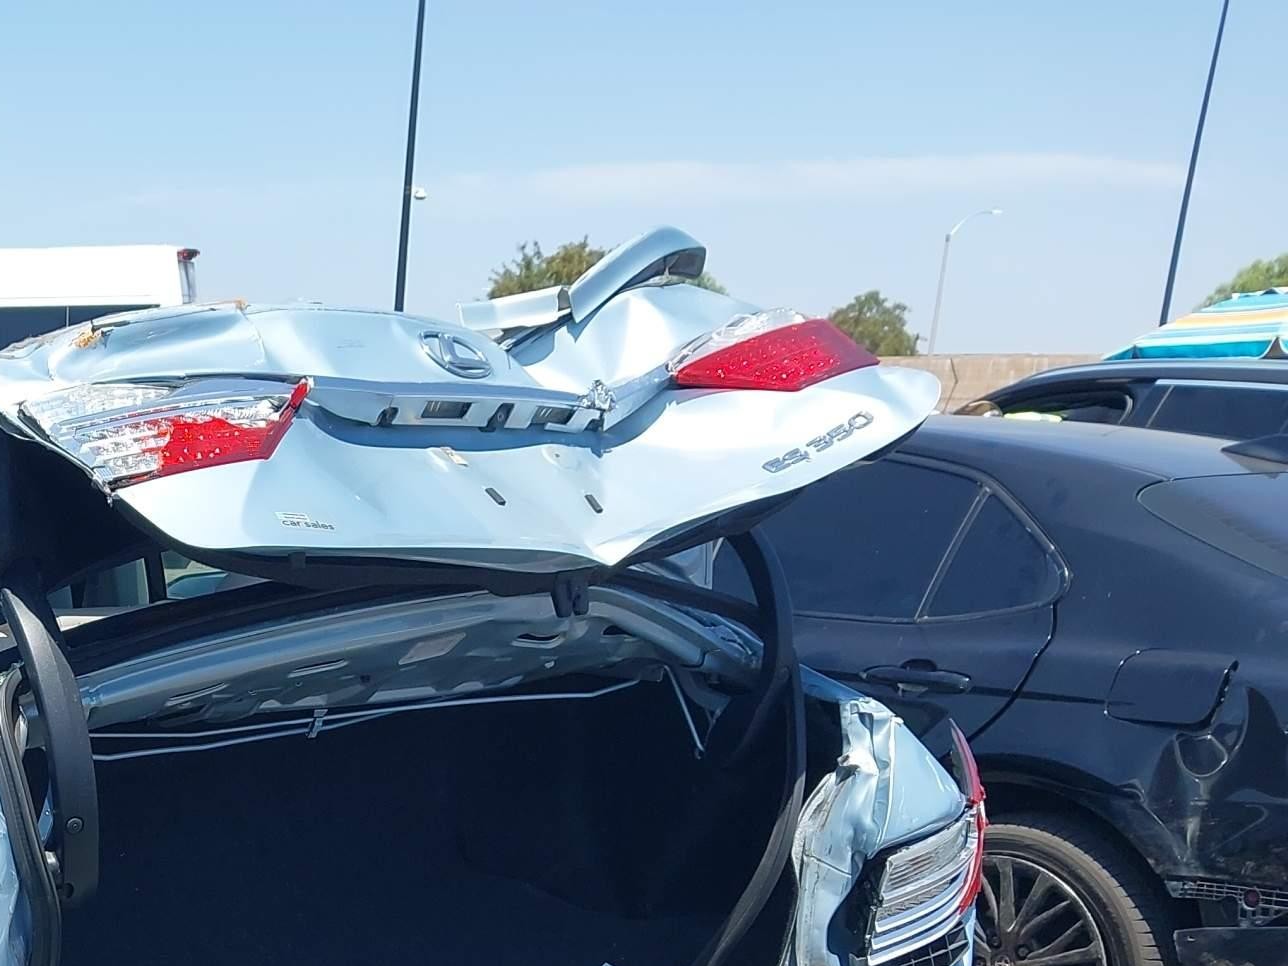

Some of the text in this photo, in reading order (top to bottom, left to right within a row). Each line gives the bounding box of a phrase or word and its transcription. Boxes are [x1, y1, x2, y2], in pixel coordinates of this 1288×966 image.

[761, 410, 874, 474] ES 350
[281, 520, 335, 530] car sales
